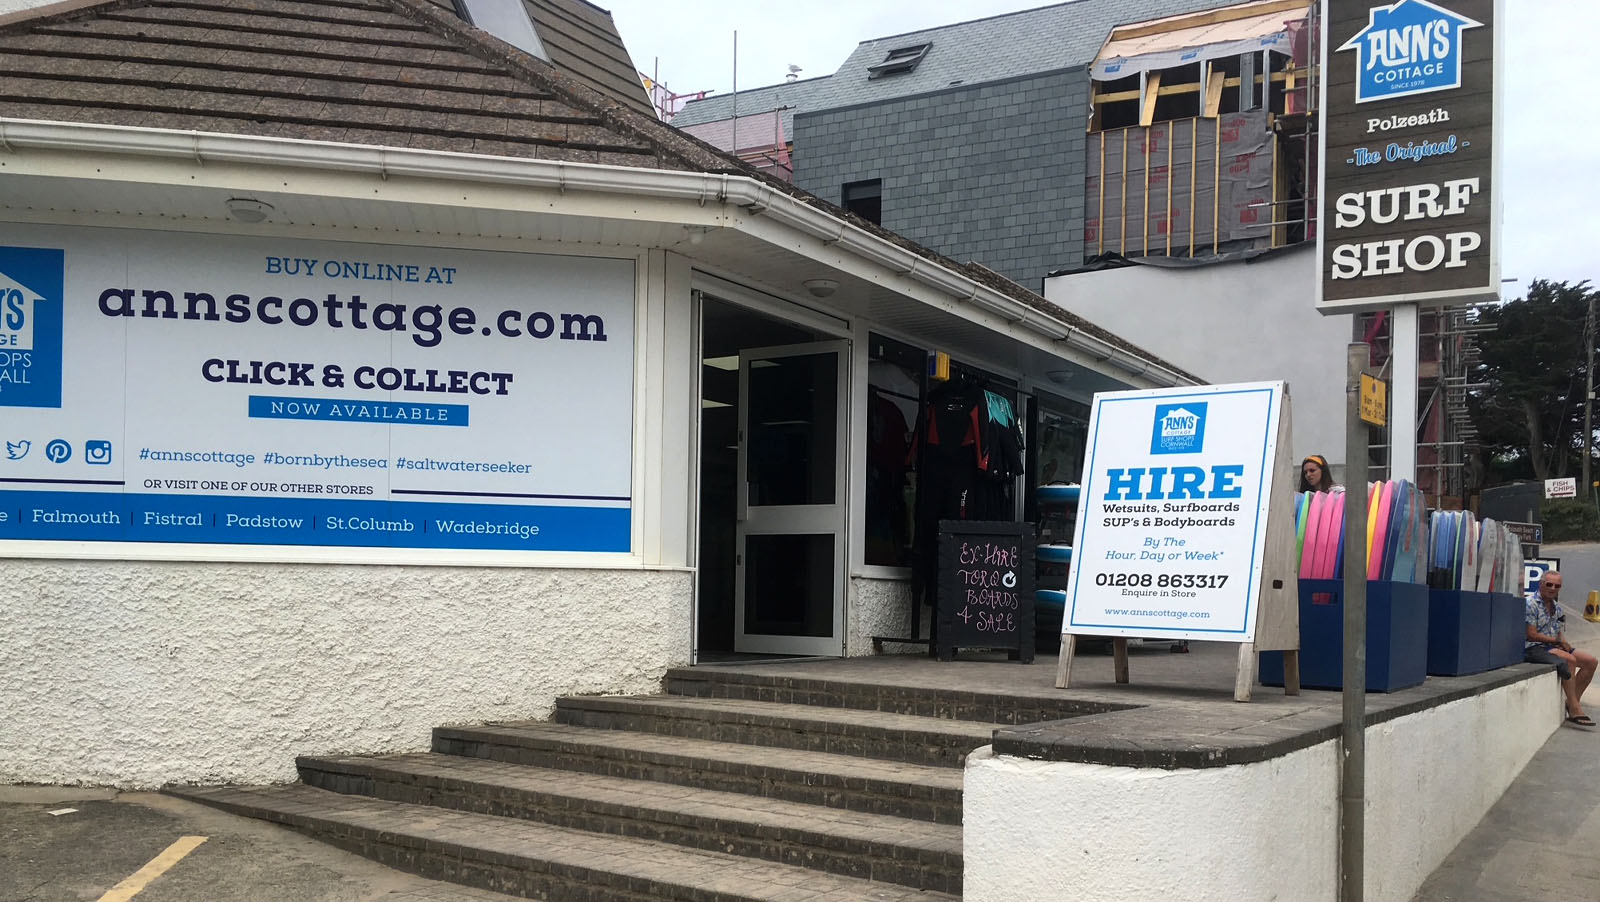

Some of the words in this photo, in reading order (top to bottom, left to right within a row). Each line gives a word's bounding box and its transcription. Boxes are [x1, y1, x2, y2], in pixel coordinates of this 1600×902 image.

[1366, 18, 1450, 71] ANN'S
[1374, 62, 1444, 83] COTTAGE
[1366, 108, 1450, 133] Polzeath
[1335, 177, 1479, 229] SURF
[1331, 231, 1482, 280] SHOP
[265, 256, 318, 276] BUY
[323, 260, 419, 283] ONLINE
[425, 266, 456, 284] AT
[98, 287, 607, 348] annscottage.com
[201, 358, 314, 388] CLICK
[322, 364, 345, 388] &
[353, 365, 513, 395] COLLECT
[271, 401, 321, 416] NOW
[329, 404, 449, 422] AVAILABLE
[139, 448, 255, 467] #annscottage
[263, 451, 388, 471] #bornbythesea
[396, 457, 532, 474] #saltwaterseeker
[143, 478, 162, 489] OR
[164, 479, 199, 490] VISIT
[200, 480, 228, 491] ONE
[230, 480, 248, 492] OF
[250, 481, 278, 493] OUR
[280, 482, 323, 494] OTHER
[325, 484, 374, 495] STORES
[1103, 464, 1244, 501] HIRE
[1102, 503, 1160, 514] Wetsuits,
[1163, 502, 1240, 513] Surfboards
[32, 508, 120, 525] Falmouth
[143, 511, 202, 526] Fistral
[225, 513, 304, 529] Padstow
[326, 516, 414, 532] St.Columb
[436, 519, 540, 539] Wadebridge
[1103, 517, 1140, 527] SUP's
[1142, 517, 1151, 527] &
[1153, 516, 1236, 529] Bodyboards
[1143, 537, 1160, 548] By
[1163, 537, 1186, 547] The
[1105, 551, 1137, 561] Hour,
[1139, 551, 1165, 563] Day
[1167, 552, 1181, 561] or
[957, 569, 1000, 588] TORQ
[1095, 573, 1153, 588] 01208
[1157, 574, 1229, 589] 863317
[1524, 566, 1543, 589] P
[965, 588, 1019, 610] BOARDS
[1121, 588, 1158, 599] Enquire
[1160, 589, 1169, 597] in
[1170, 589, 1197, 598] Store
[957, 605, 973, 624] 4
[976, 611, 1016, 633] SALE
[1104, 607, 1211, 619] www.annscottage.com
